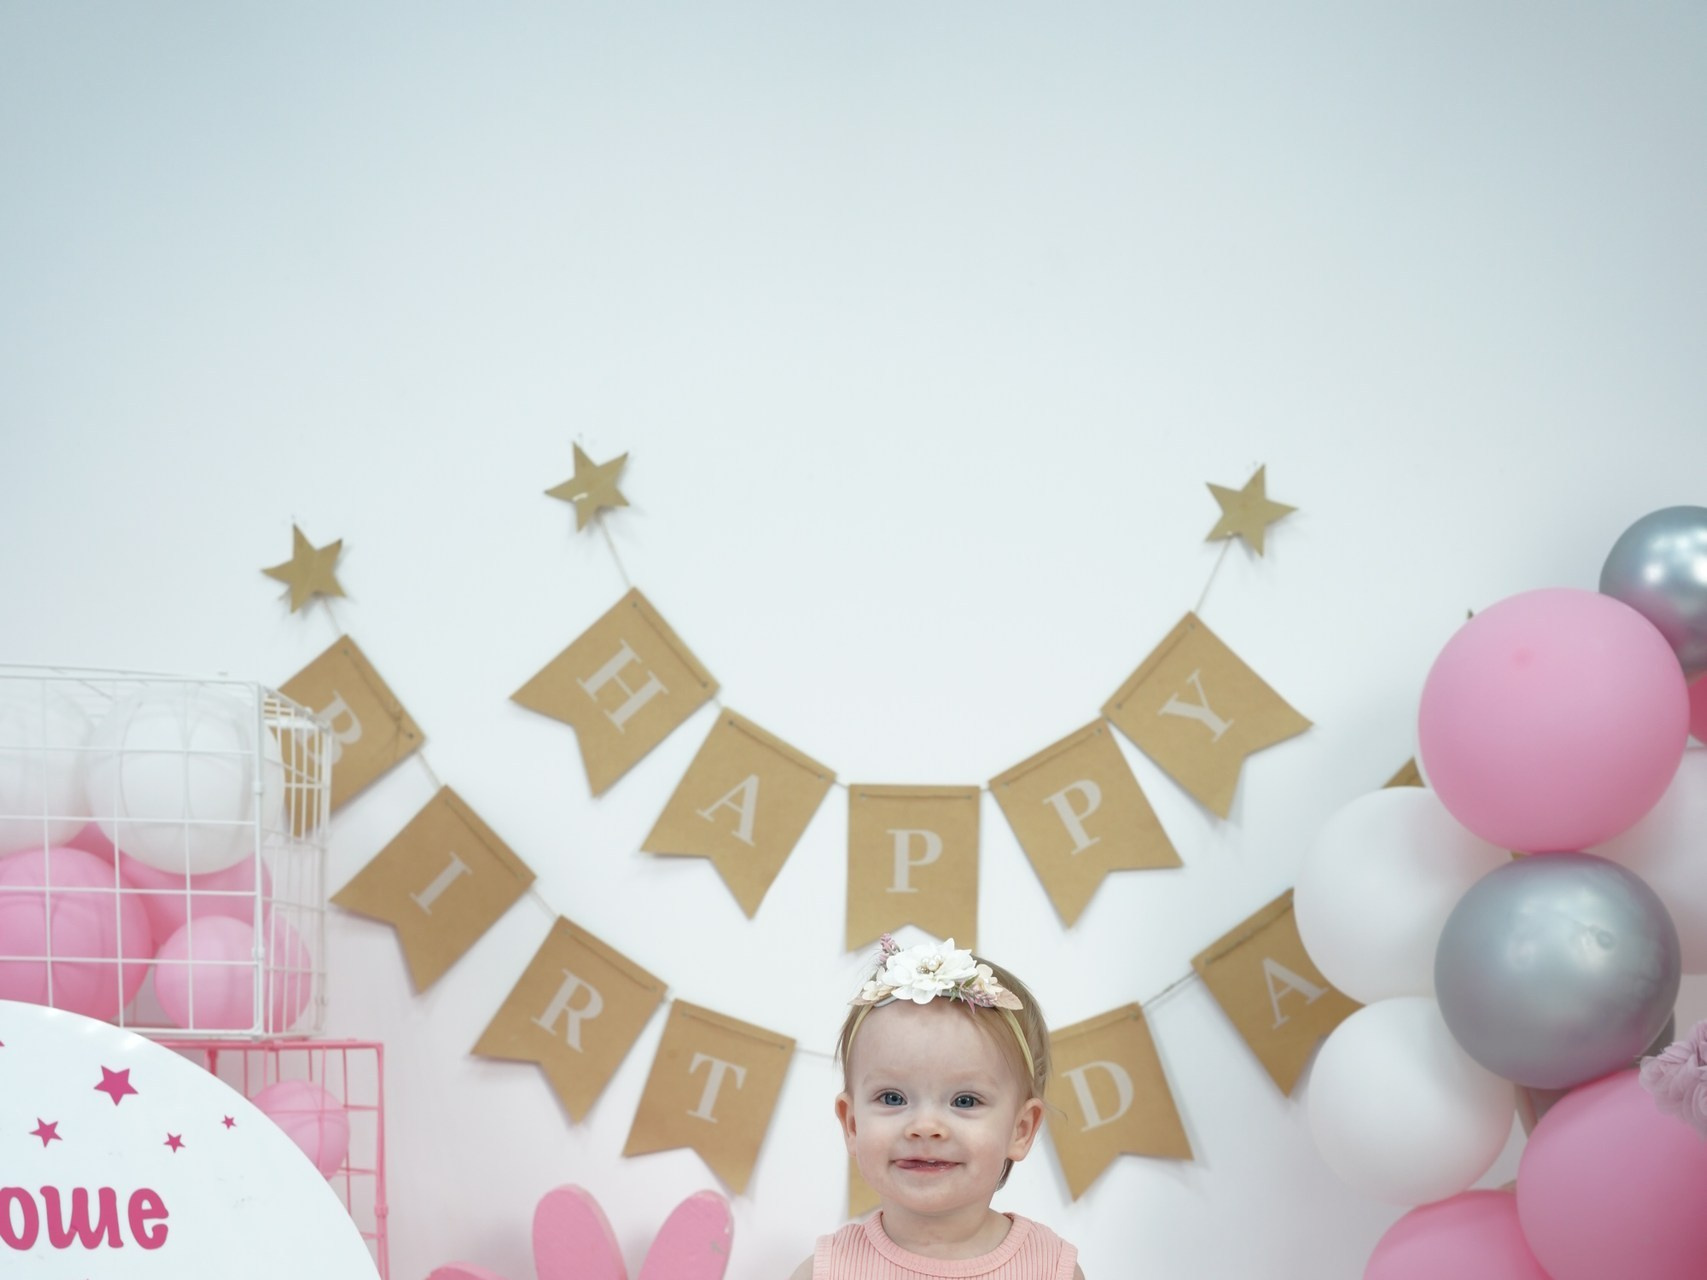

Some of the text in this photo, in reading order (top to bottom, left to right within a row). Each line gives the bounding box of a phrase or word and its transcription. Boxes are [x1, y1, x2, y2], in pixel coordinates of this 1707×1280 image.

[576, 638, 1236, 894] HAPPY
[296, 689, 1330, 1133] BIRTDA
[0, 1185, 169, 1251] оше
